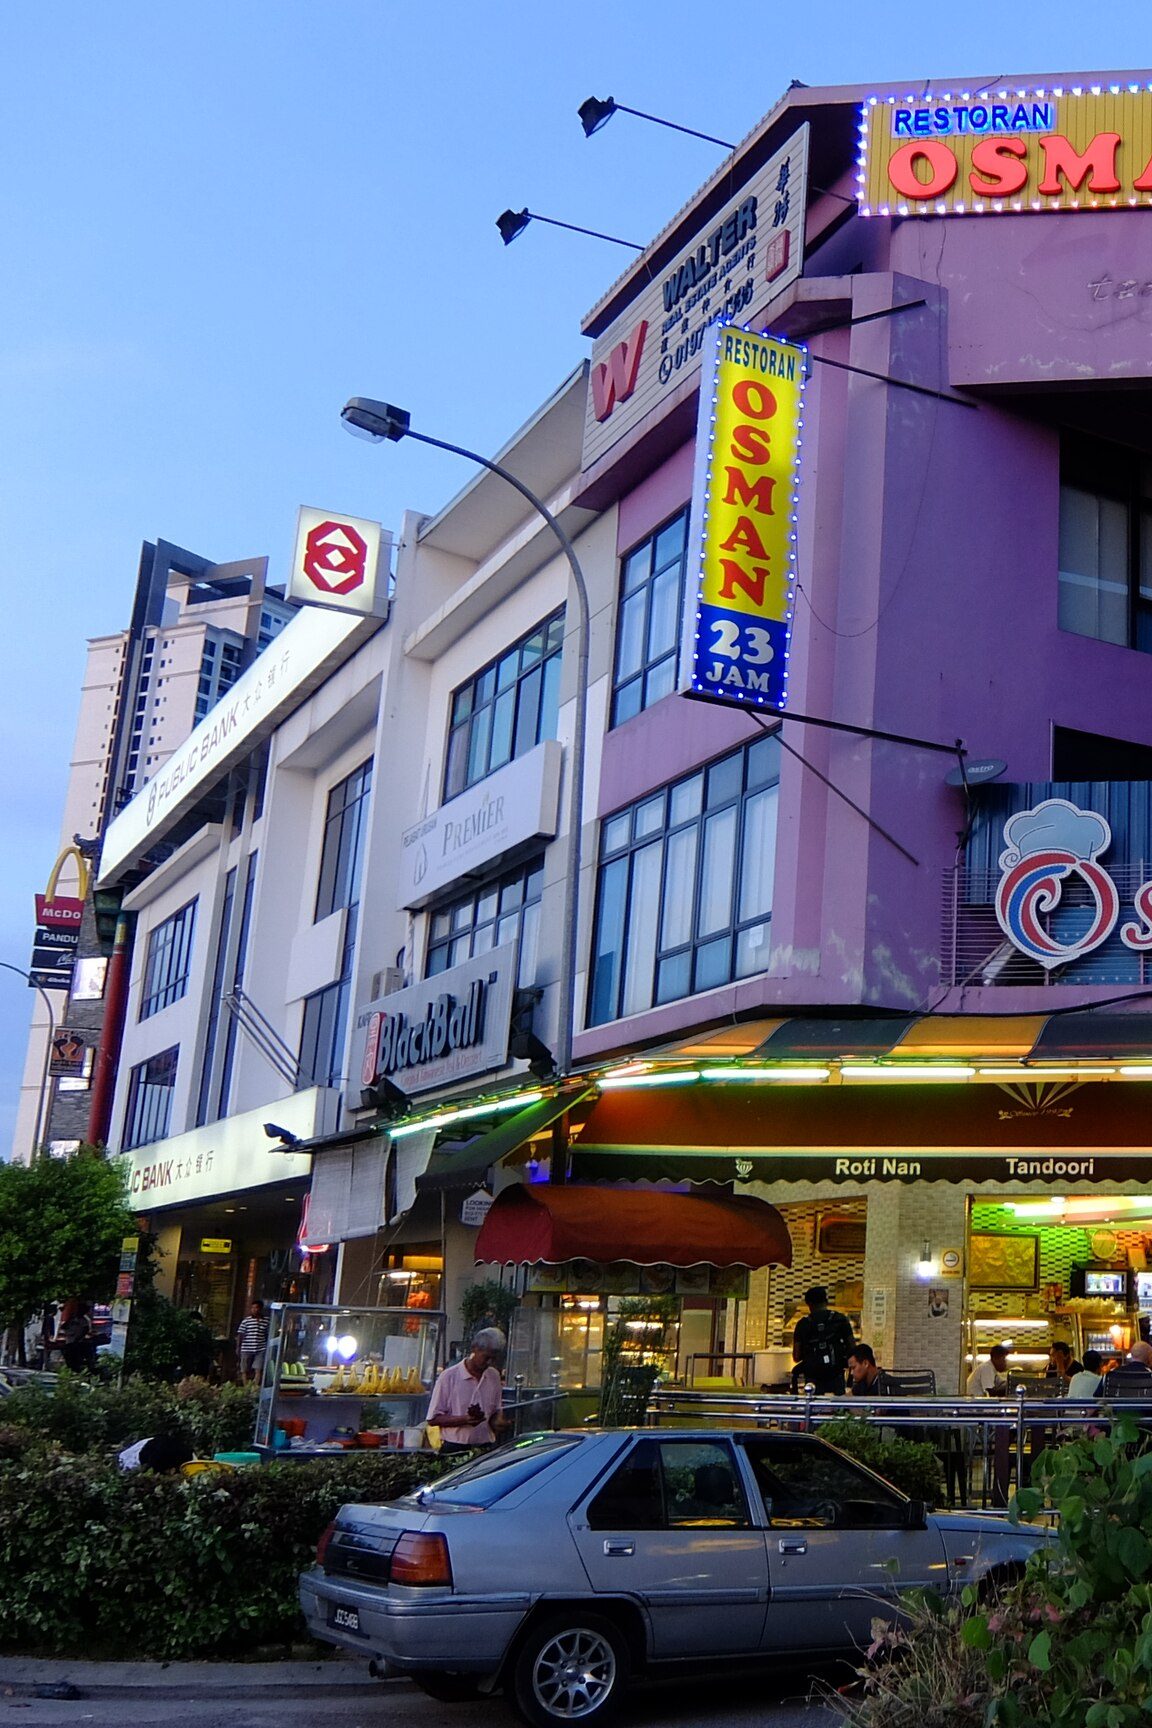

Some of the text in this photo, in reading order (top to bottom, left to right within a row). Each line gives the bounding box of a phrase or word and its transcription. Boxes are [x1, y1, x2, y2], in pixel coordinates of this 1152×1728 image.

[893, 102, 1051, 134] RESTORAN
[662, 195, 758, 313] WALTER
[661, 307, 683, 336] REAL
[718, 235, 758, 281] AGENTS
[591, 320, 649, 424] W
[724, 334, 796, 382] RESTORAN
[718, 380, 778, 607] OSMAN
[708, 619, 775, 665] 23
[705, 663, 770, 694] JAM
[158, 745, 199, 807] PUBLIC
[200, 700, 240, 763] BANK
[967, 764, 995, 774] astro
[42, 931, 79, 944] PANDU
[375, 978, 486, 1077] BlackBall
[141, 1158, 175, 1192] BANK
[834, 1157, 922, 1176] Roti Nan
[1005, 1157, 1095, 1176] Tandoori
